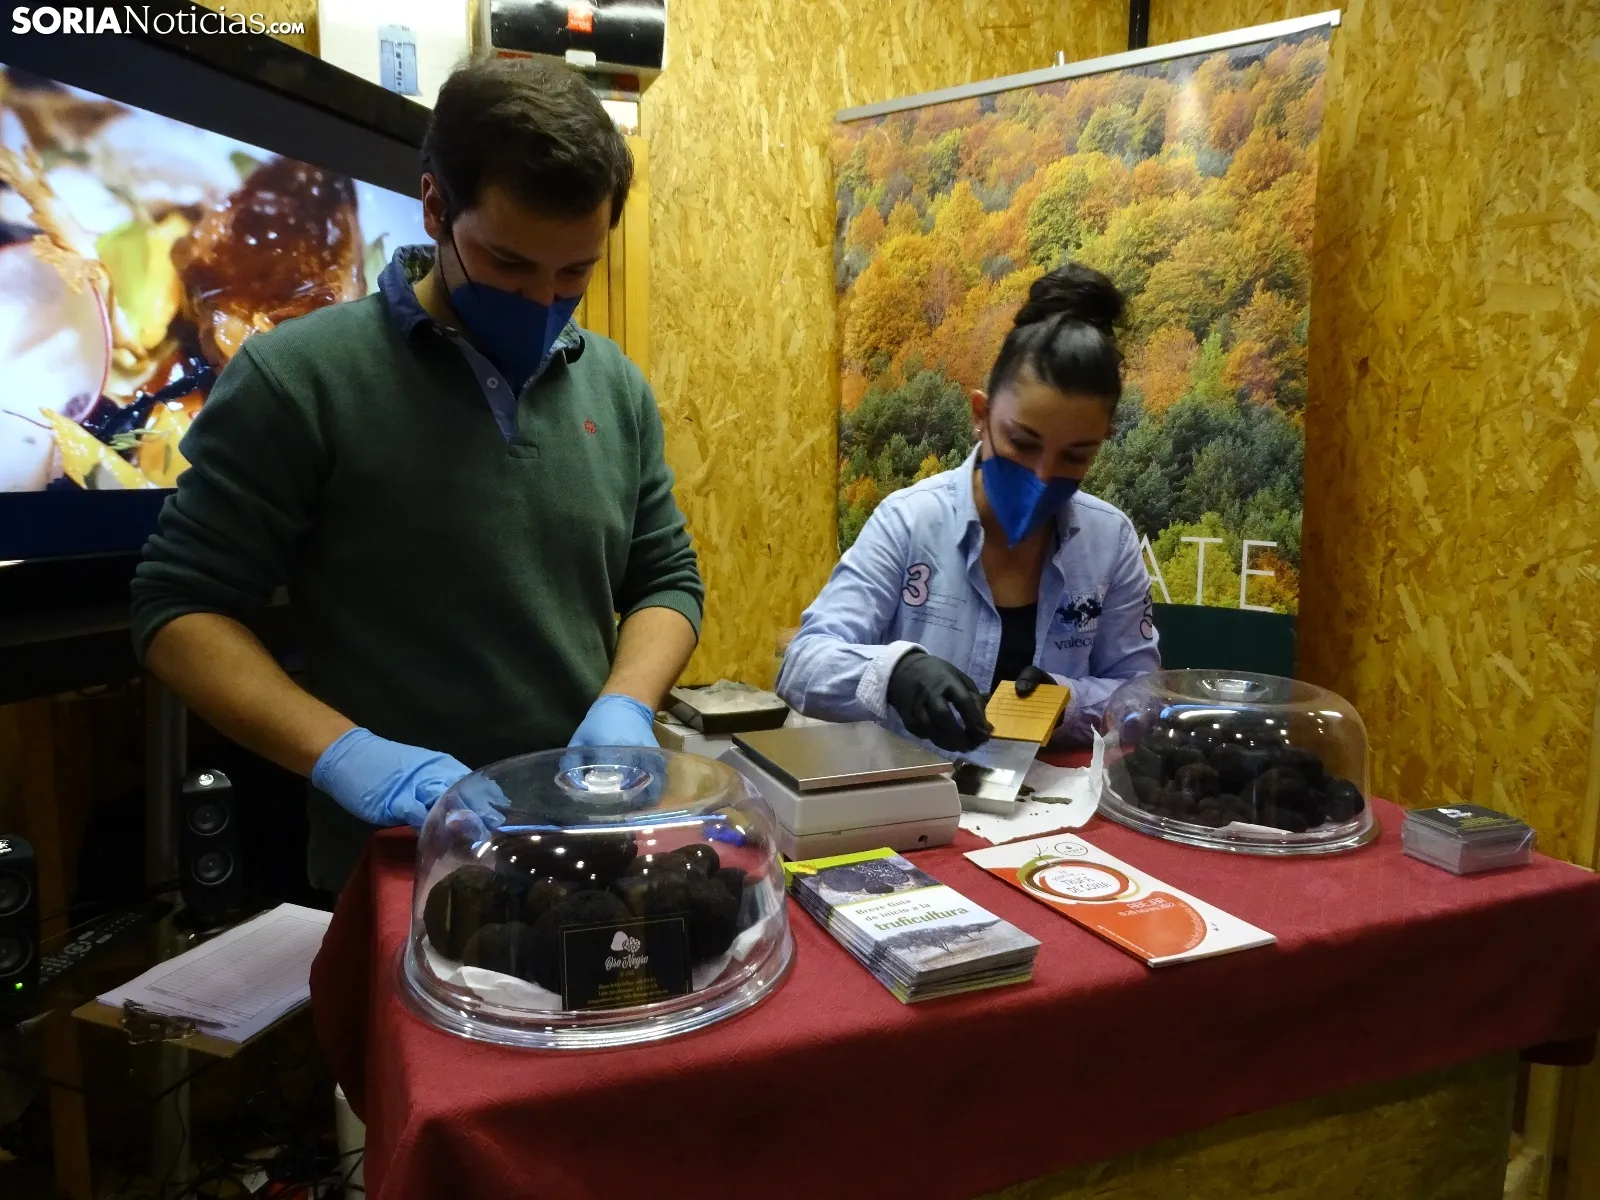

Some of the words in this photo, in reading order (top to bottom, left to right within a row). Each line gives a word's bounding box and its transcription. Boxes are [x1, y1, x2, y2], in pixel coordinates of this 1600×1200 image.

[902, 563, 931, 607] 3
[855, 903, 886, 915] Breve
[879, 907, 910, 918] inicio
[873, 907, 970, 931] truficultura
